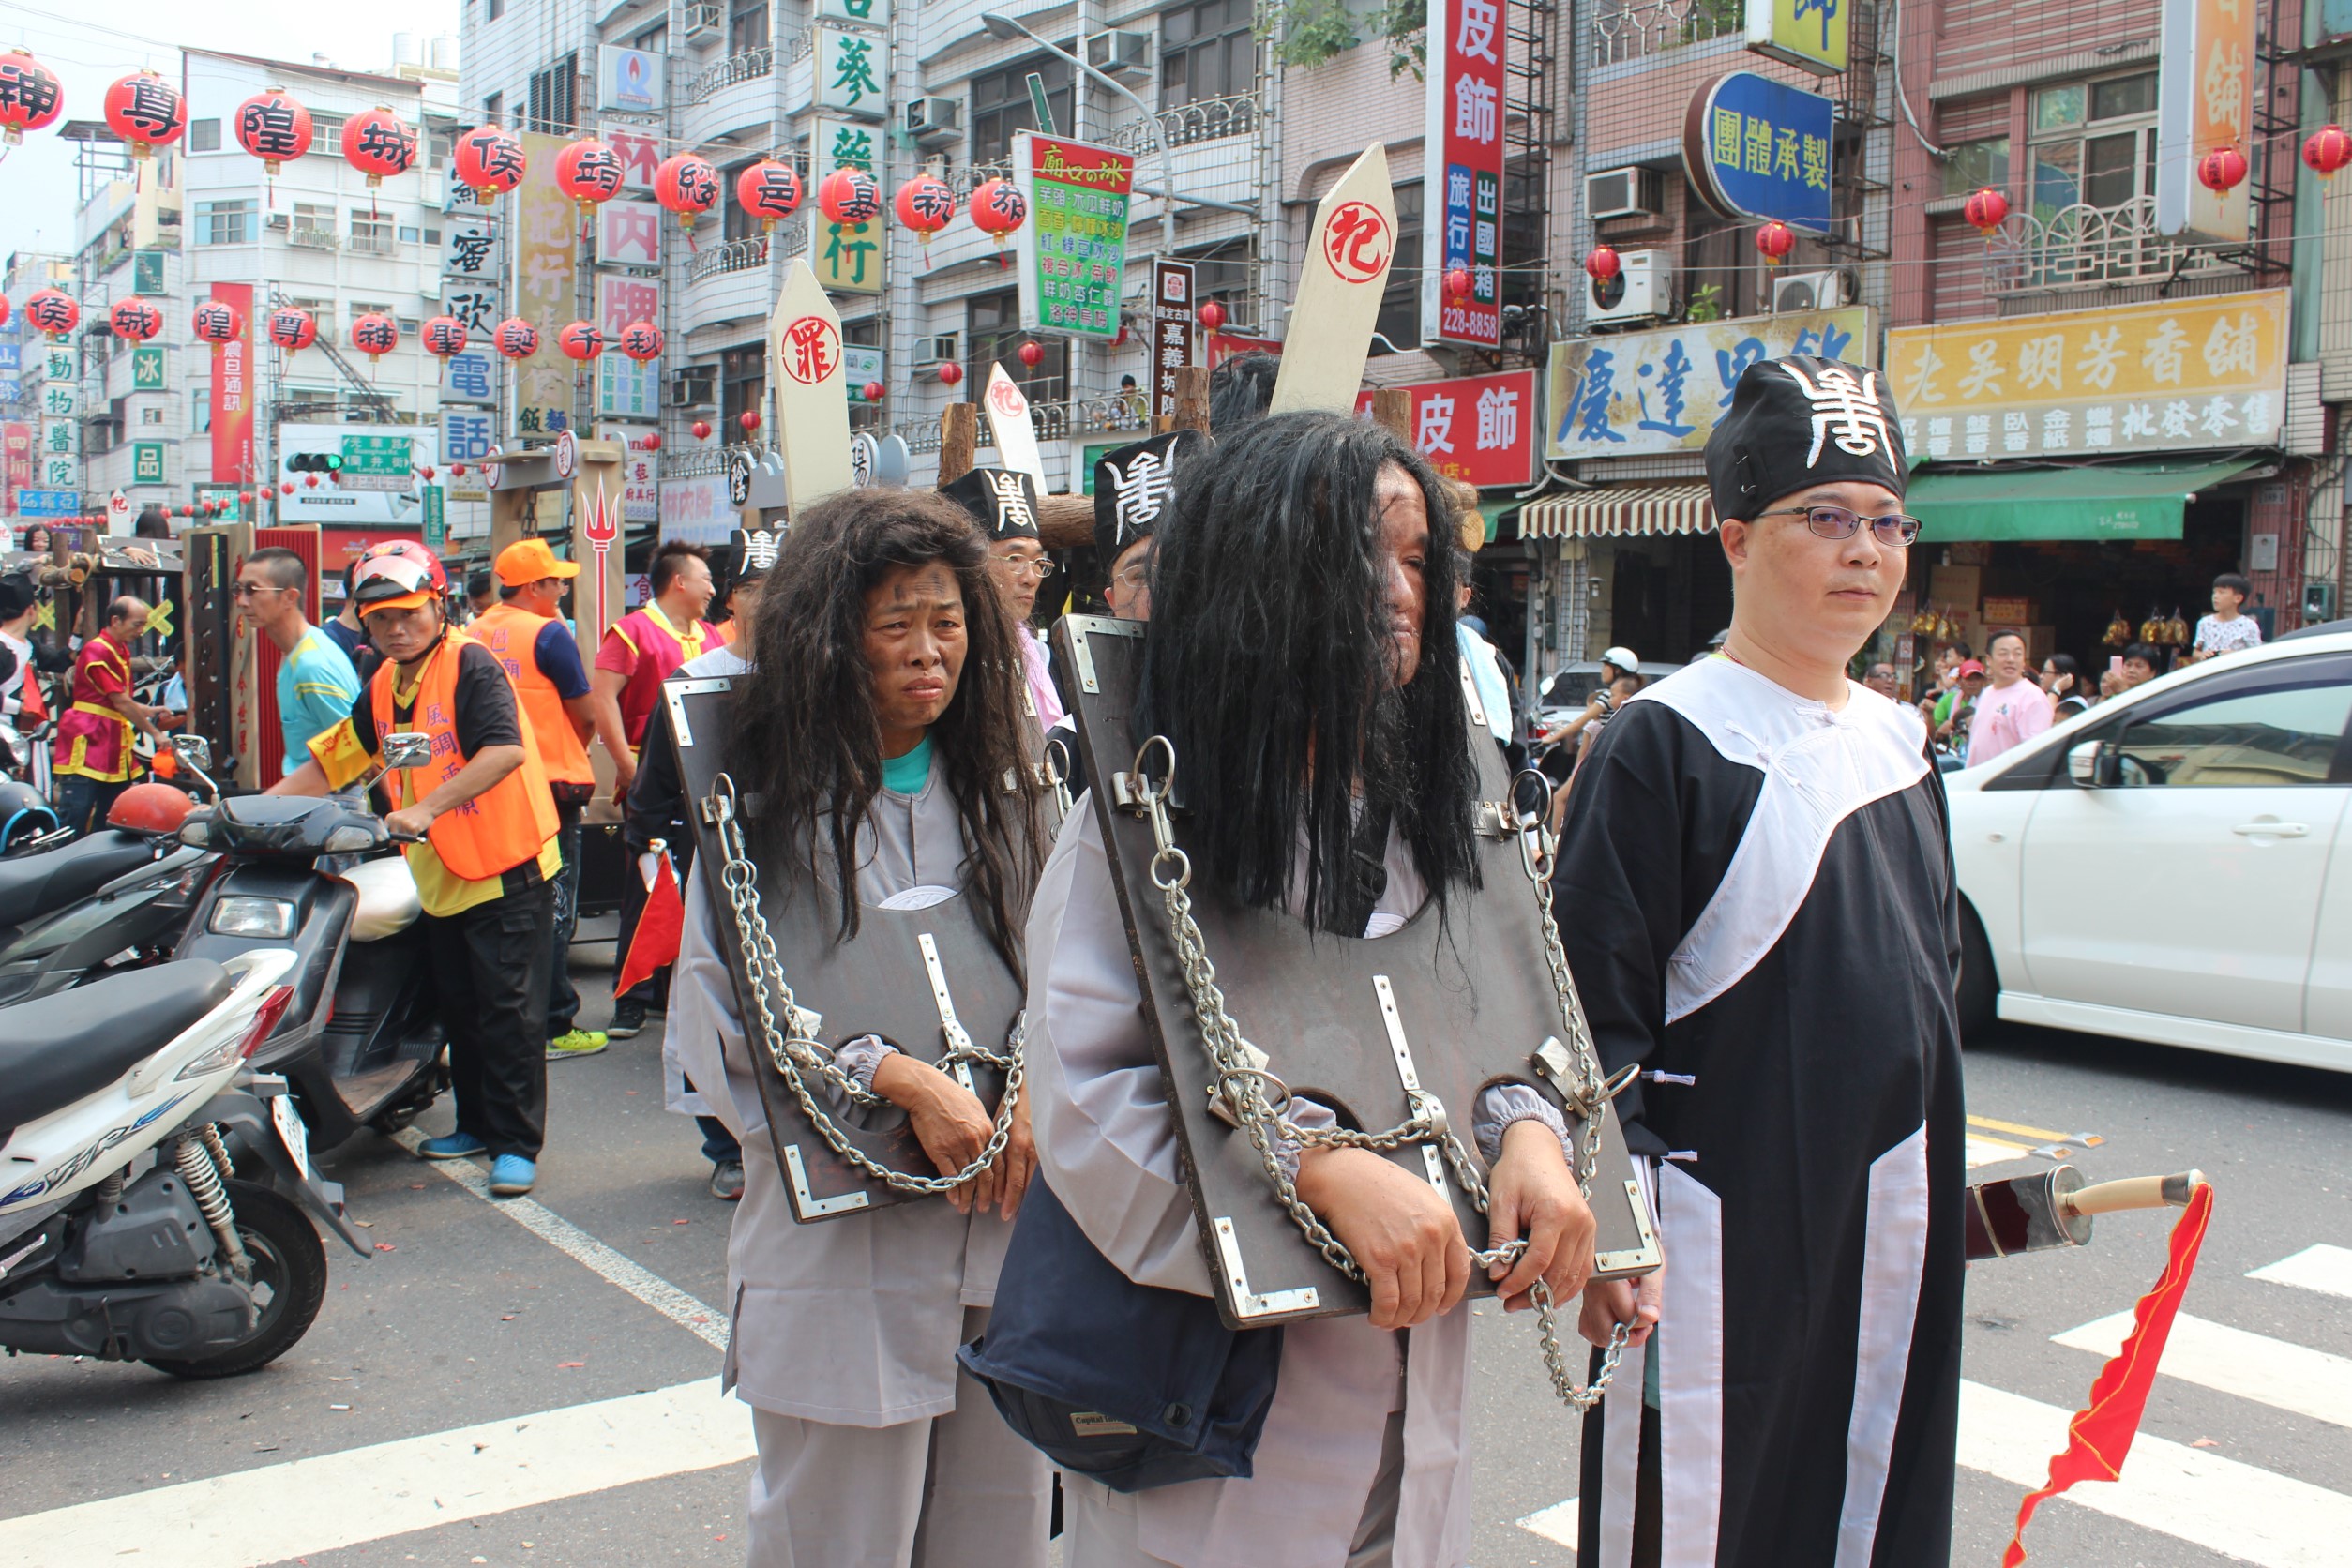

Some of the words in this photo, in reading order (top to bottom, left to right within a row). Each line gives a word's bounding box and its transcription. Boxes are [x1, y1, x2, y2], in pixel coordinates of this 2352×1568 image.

[0, 64, 60, 122] 神
[122, 78, 185, 137] 尊
[243, 98, 299, 157] 隍
[358, 122, 415, 173] 城
[822, 0, 881, 284] 蔘藥行
[1713, 106, 1828, 191] 團體承製
[471, 135, 525, 185] 侯
[573, 150, 625, 195] 靖
[758, 168, 795, 215] 邑
[912, 184, 953, 224] 祝
[1474, 178, 1497, 300] 出國箱
[31, 296, 72, 330] 侯
[115, 305, 153, 339] 城
[198, 308, 233, 339] 隍
[273, 311, 309, 346] 尊
[357, 322, 396, 349] 神
[1442, 306, 1498, 339] 228-8858
[428, 324, 463, 354] 聖
[503, 325, 536, 354] 誕
[568, 327, 603, 355] 千
[626, 329, 663, 356] 秋
[791, 320, 832, 381] 罪
[447, 353, 490, 460] 電話
